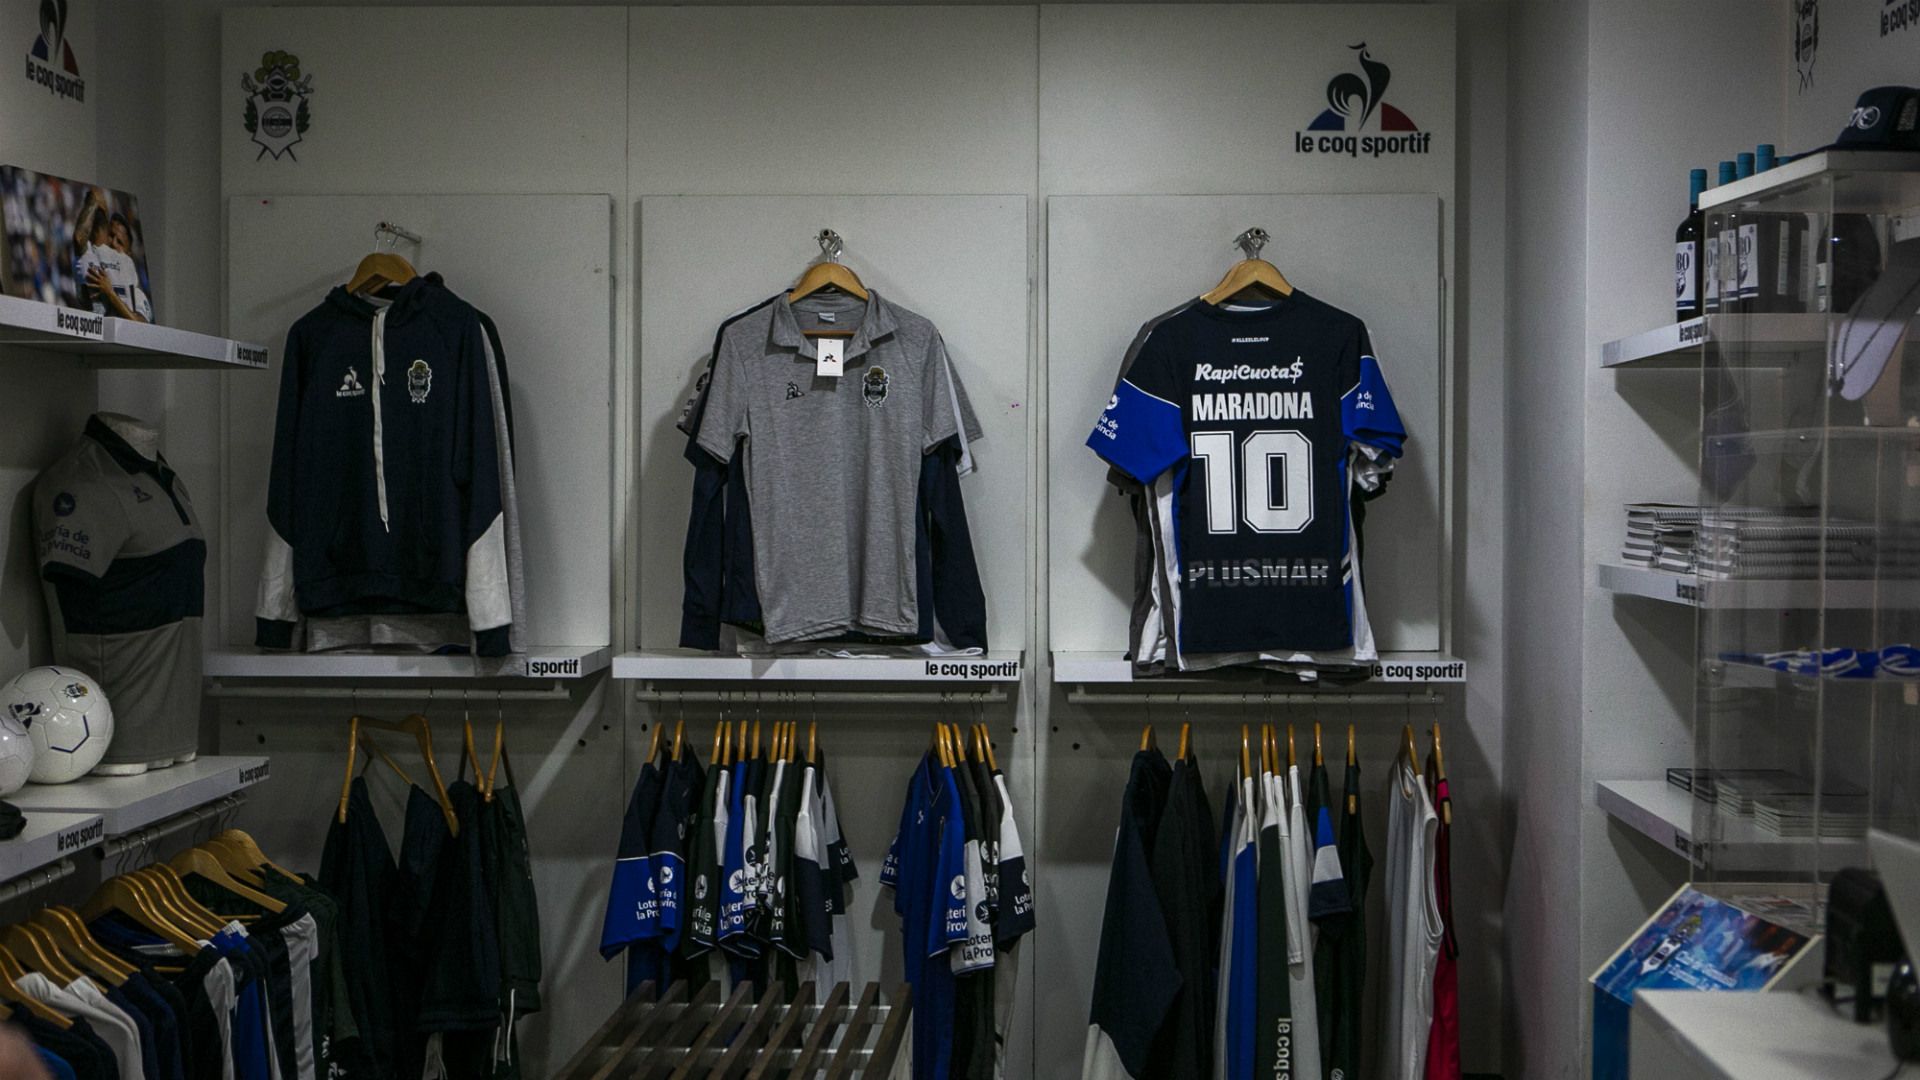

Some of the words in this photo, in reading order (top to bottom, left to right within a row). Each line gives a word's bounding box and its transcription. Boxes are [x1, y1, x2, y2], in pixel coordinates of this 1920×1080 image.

[1880, 10, 1889, 37] le
[1890, 3, 1907, 31] coq
[26, 54, 35, 80] le
[36, 65, 54, 95] coq
[55, 73, 85, 103] sportif
[1296, 131, 1313, 153] le
[1318, 136, 1357, 158] coq
[1361, 132, 1431, 158] sportif
[57, 308, 64, 328] le
[65, 314, 79, 335] coq
[80, 315, 103, 336] sportif
[1194, 355, 1304, 385] RapiCuota$
[1191, 391, 1315, 422] MARADONA
[1190, 429, 1315, 535] 10
[73, 529, 89, 545] de
[1188, 557, 1329, 589] PLUSMAR
[532, 659, 578, 676] sportif
[925, 660, 939, 676] le
[941, 663, 968, 679] coq
[970, 662, 1018, 679] sportif
[1370, 663, 1384, 677] le
[1386, 665, 1413, 681] coq
[1415, 663, 1464, 681] sportif
[57, 832, 64, 851] le
[65, 830, 79, 849] coq
[80, 817, 103, 846] sportif
[1278, 1017, 1292, 1034] le
[1273, 1036, 1291, 1070] coq
